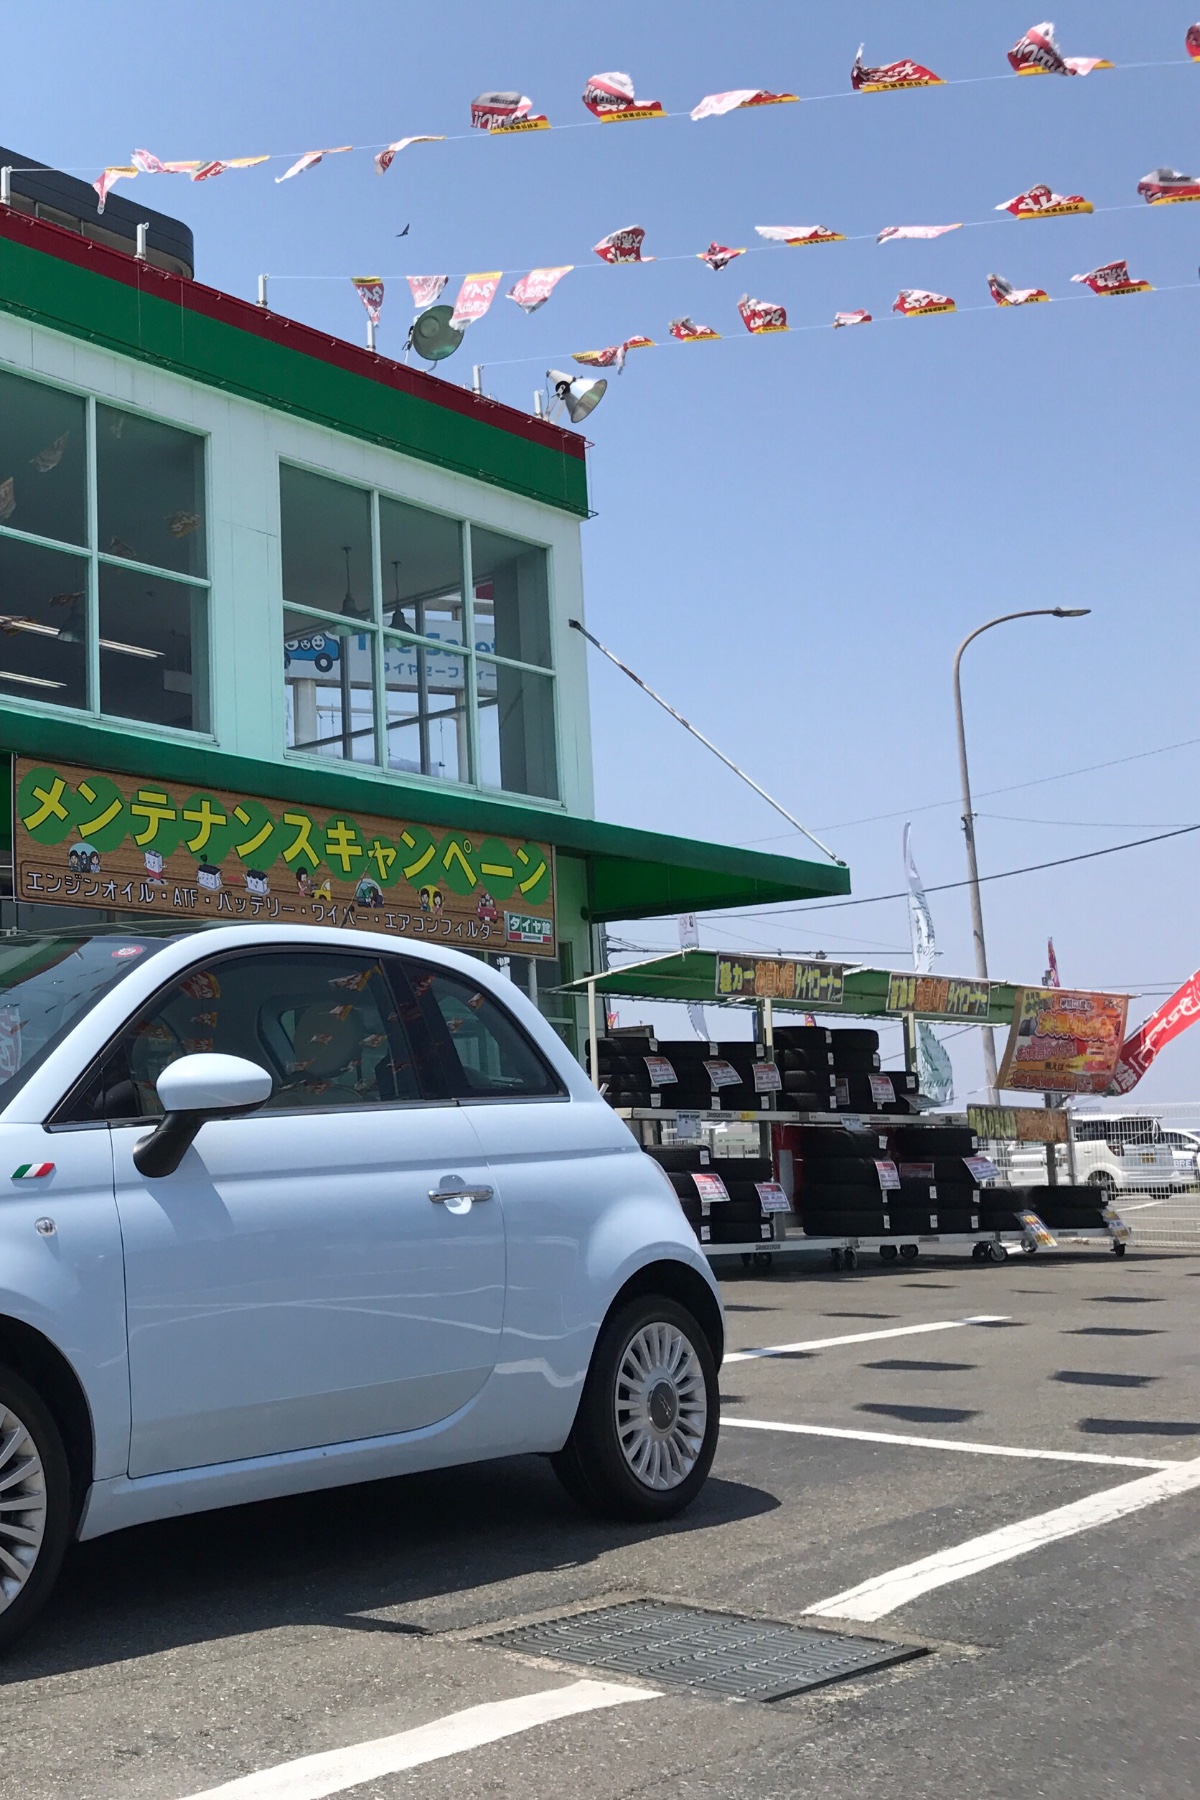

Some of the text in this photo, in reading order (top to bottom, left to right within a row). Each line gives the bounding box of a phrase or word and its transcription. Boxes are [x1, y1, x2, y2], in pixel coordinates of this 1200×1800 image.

[22, 777, 547, 895] メンテナンスキャンペーン
[510, 916, 551, 935] タイヤ館
